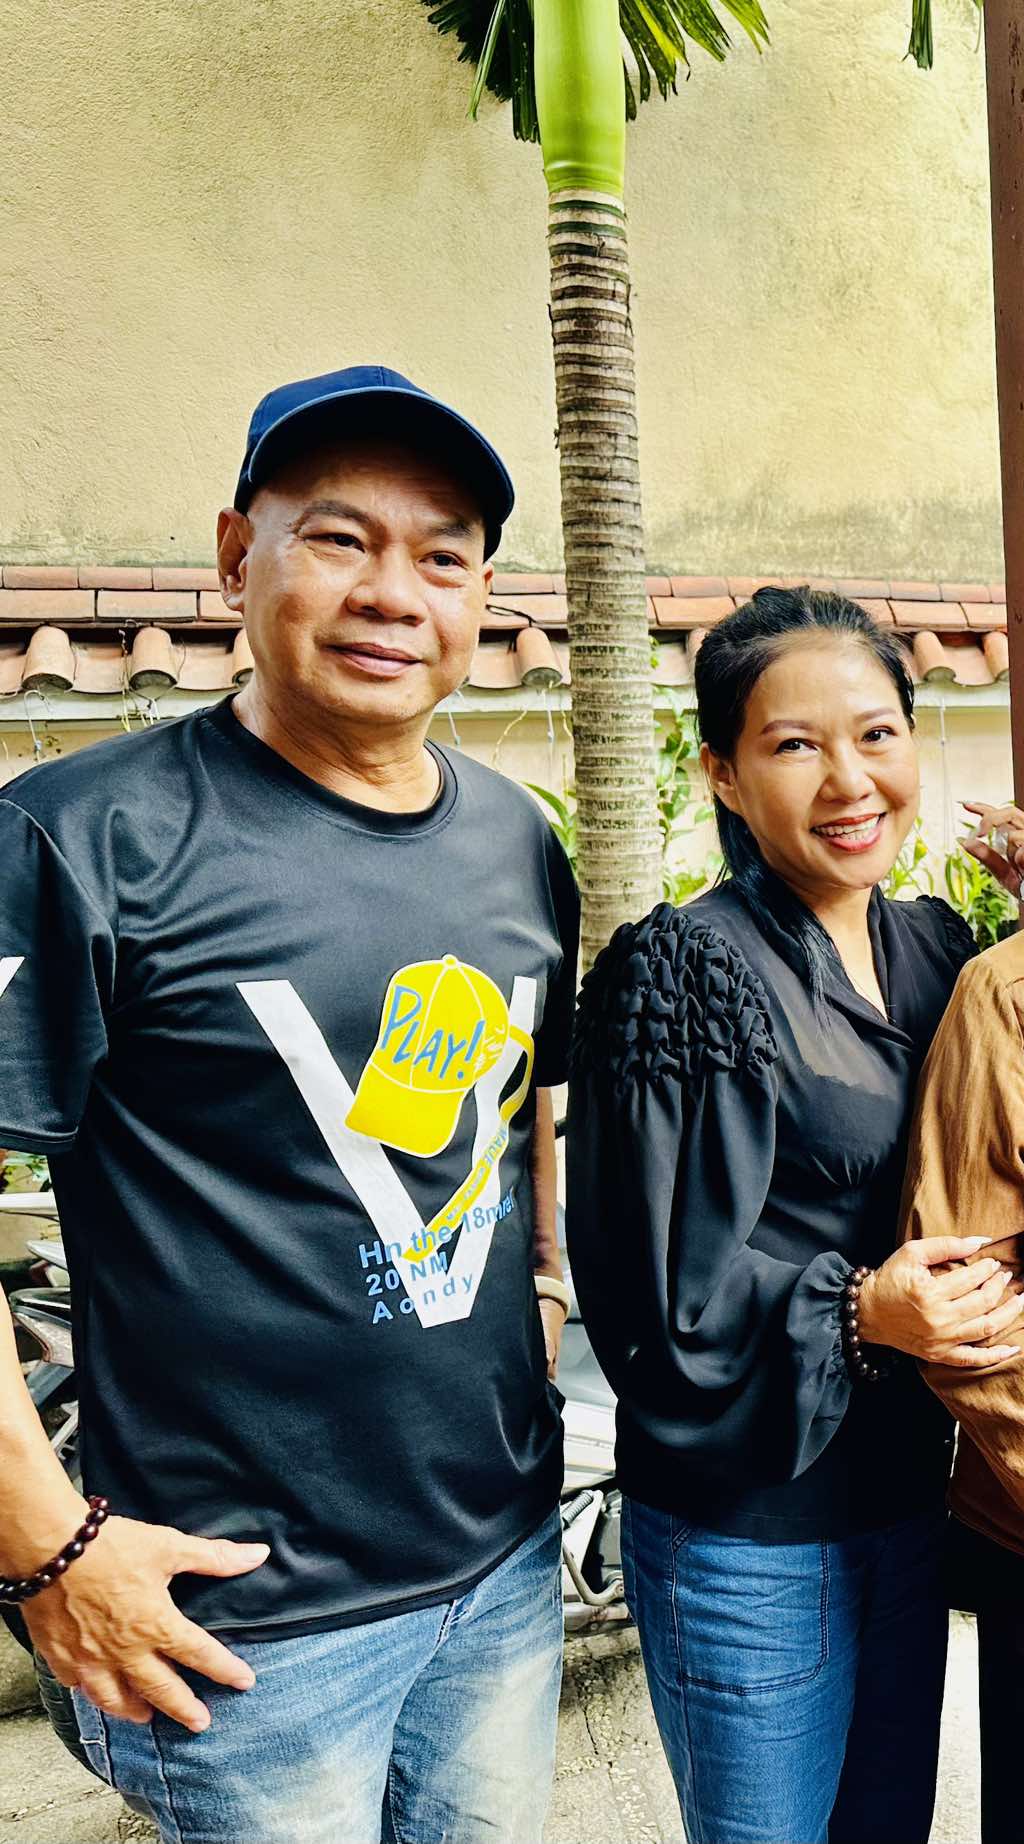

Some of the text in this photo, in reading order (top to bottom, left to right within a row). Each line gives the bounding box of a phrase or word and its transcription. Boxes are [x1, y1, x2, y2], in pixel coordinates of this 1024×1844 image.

[380, 985, 486, 1080] PLAY!
[410, 1225, 452, 1252] the
[366, 1251, 448, 1296] 20 NM
